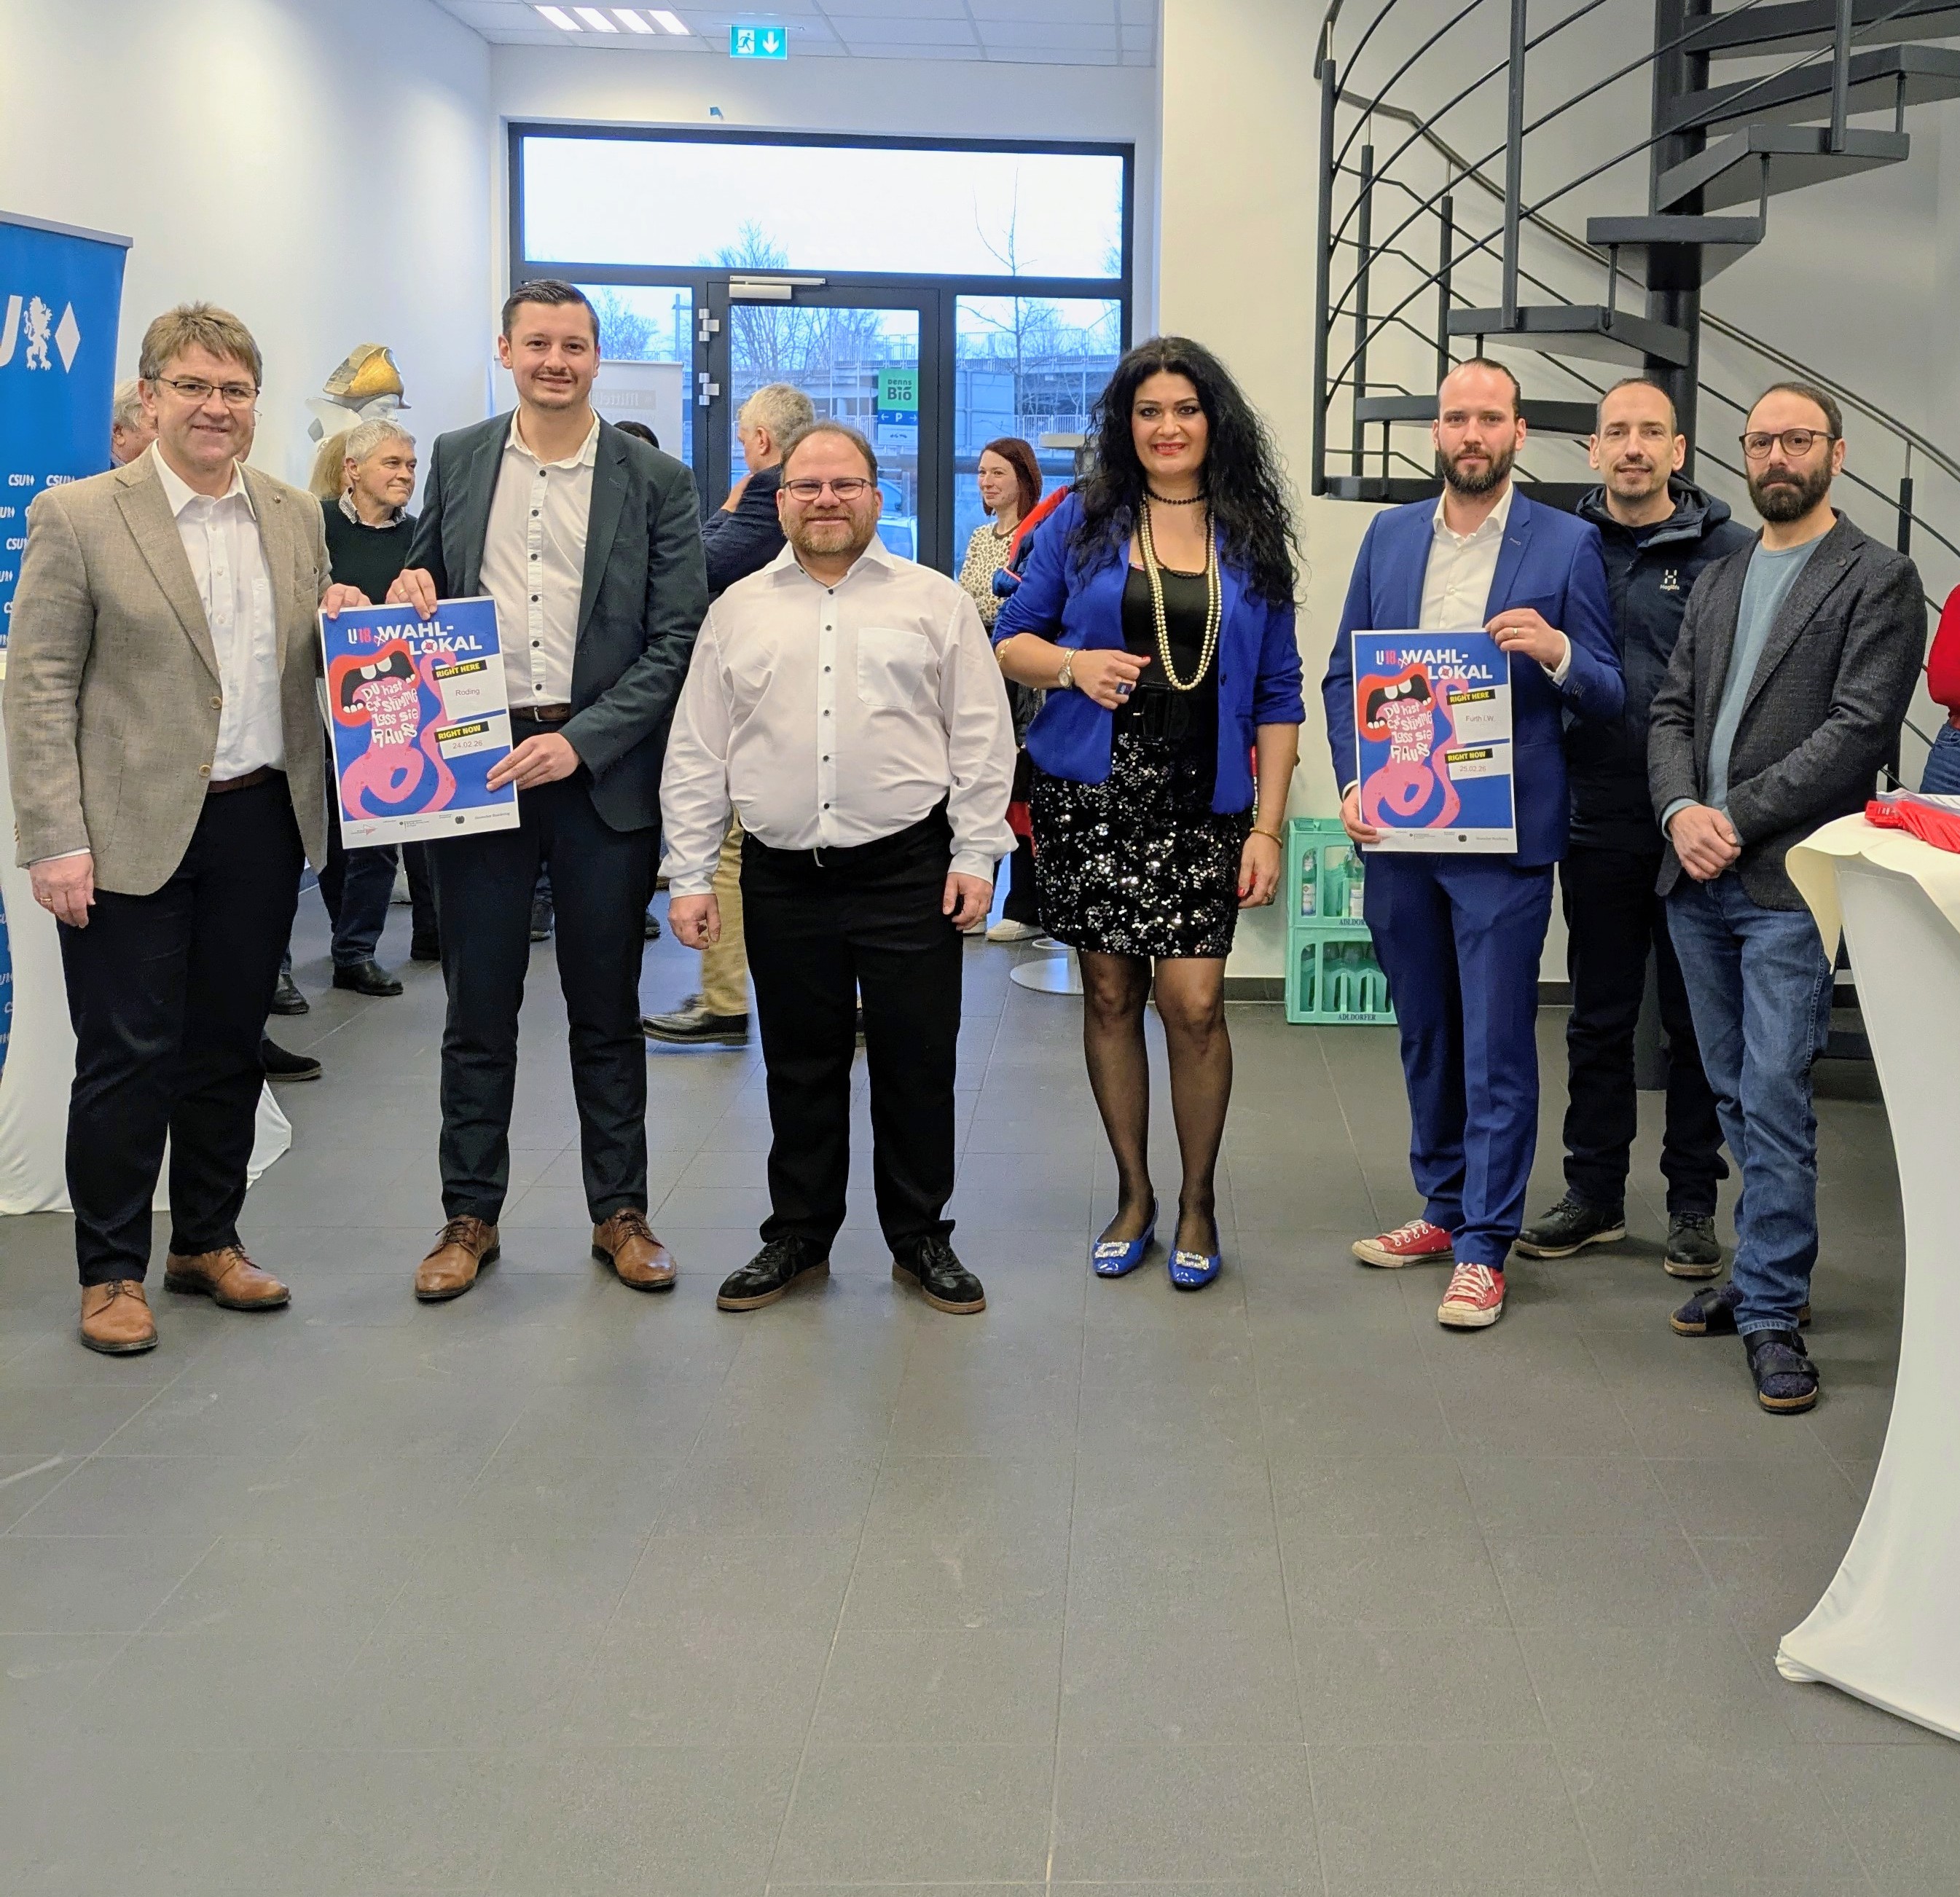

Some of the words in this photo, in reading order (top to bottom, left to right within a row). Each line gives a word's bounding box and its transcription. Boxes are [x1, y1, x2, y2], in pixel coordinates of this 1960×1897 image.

[895, 412, 903, 423] P
[8, 474, 25, 487] CSU
[46, 474, 68, 487] CSU
[6, 538, 23, 551] CSU
[348, 627, 372, 645] U18
[377, 621, 454, 641] WAHL-
[409, 635, 483, 656] LOKAL
[1401, 648, 1469, 664] WAHL-
[436, 667, 459, 678] RIGHT
[460, 662, 481, 673] HERE
[1427, 664, 1493, 680] LOKAL
[455, 688, 480, 696] Roding
[1449, 694, 1470, 703] RIGHT
[1472, 691, 1490, 699] HERE
[371, 723, 418, 748] RAUS
[438, 729, 461, 740] RIGHT
[463, 724, 481, 734] NOW
[1390, 742, 1430, 764] RAUS
[1447, 753, 1468, 762] RIGHT
[1469, 750, 1486, 758] NOW
[1339, 918, 1366, 926] ADLDOR
